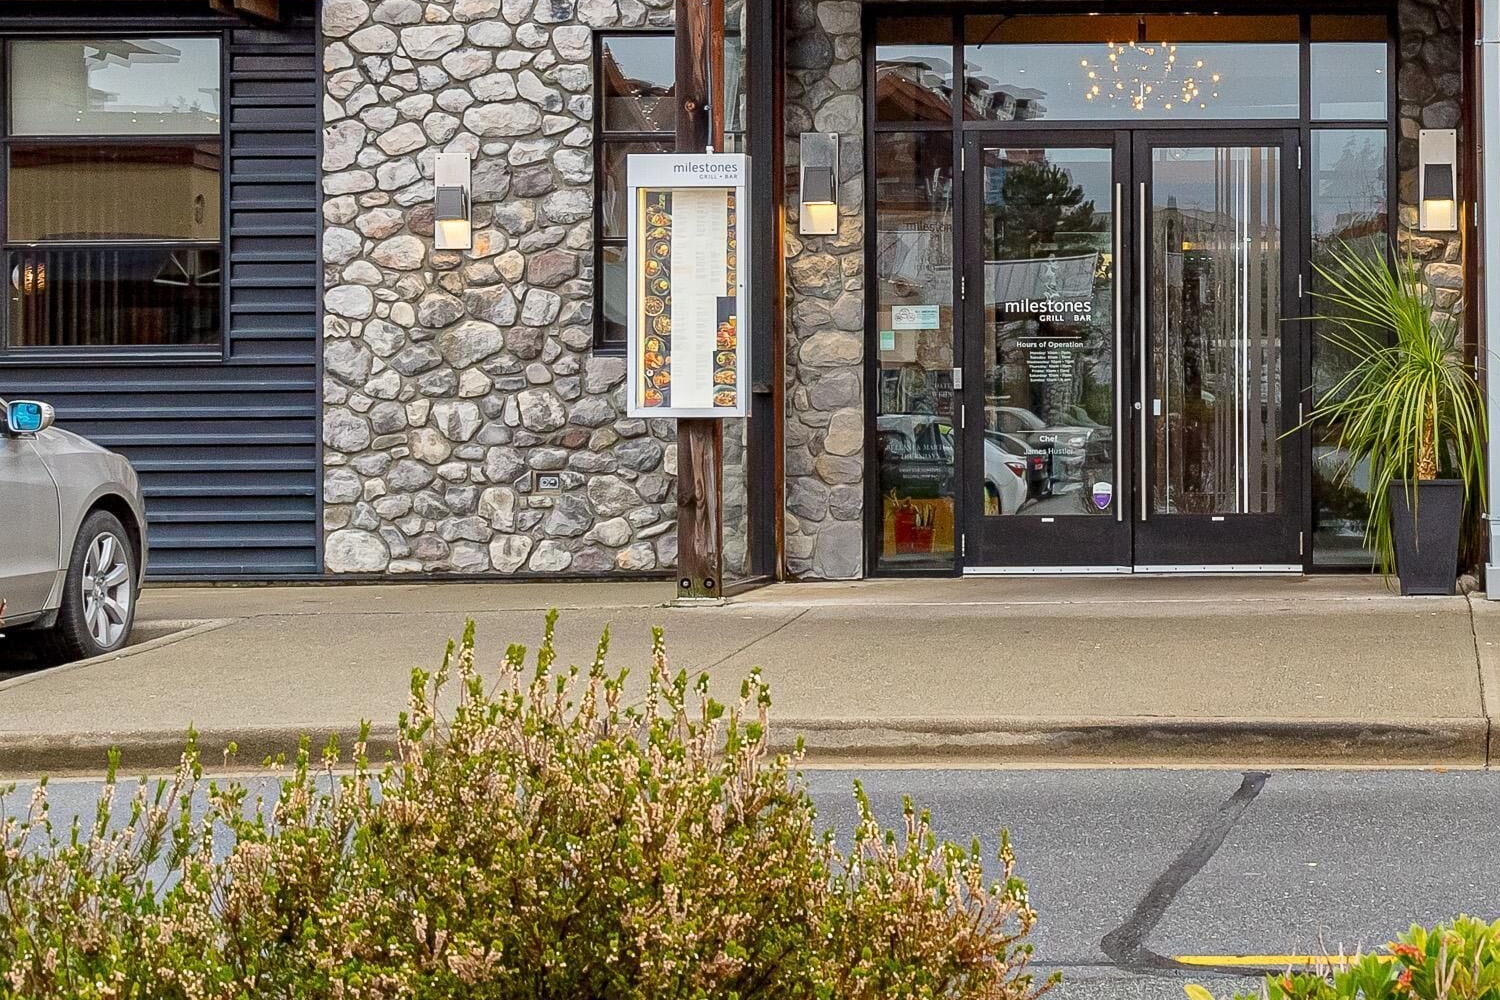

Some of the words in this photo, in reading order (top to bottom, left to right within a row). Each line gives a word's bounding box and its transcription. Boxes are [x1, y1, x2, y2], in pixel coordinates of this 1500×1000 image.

[673, 162, 738, 173] milestones
[1005, 299, 1092, 313] milestones
[1039, 314, 1065, 322] GRILL
[1073, 314, 1092, 322] BAR
[1048, 341, 1084, 349] Operation
[1039, 435, 1058, 443] Chef
[1023, 447, 1047, 455] James
